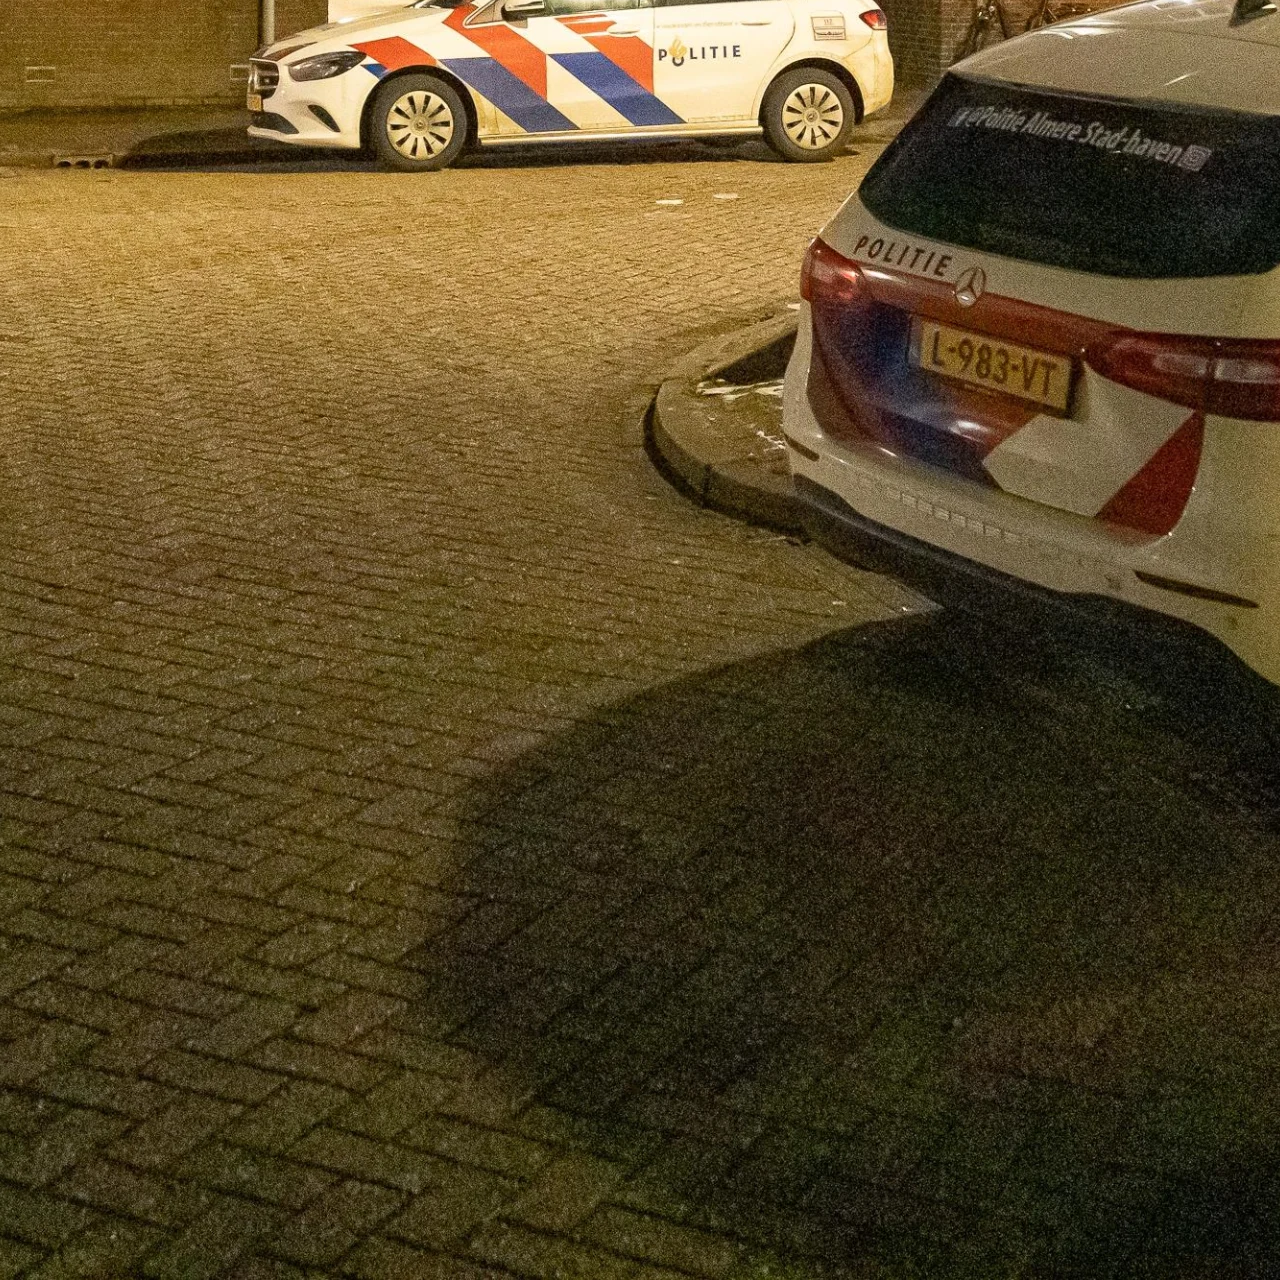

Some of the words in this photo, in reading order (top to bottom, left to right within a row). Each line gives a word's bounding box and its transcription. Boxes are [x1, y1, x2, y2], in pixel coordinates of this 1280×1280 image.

[658, 45, 741, 67] POLITIE
[1021, 111, 1083, 141] Almere
[1079, 122, 1183, 164] Stad-haven
[853, 235, 953, 277] POLITIE
[932, 329, 1058, 399] L-983-VT
